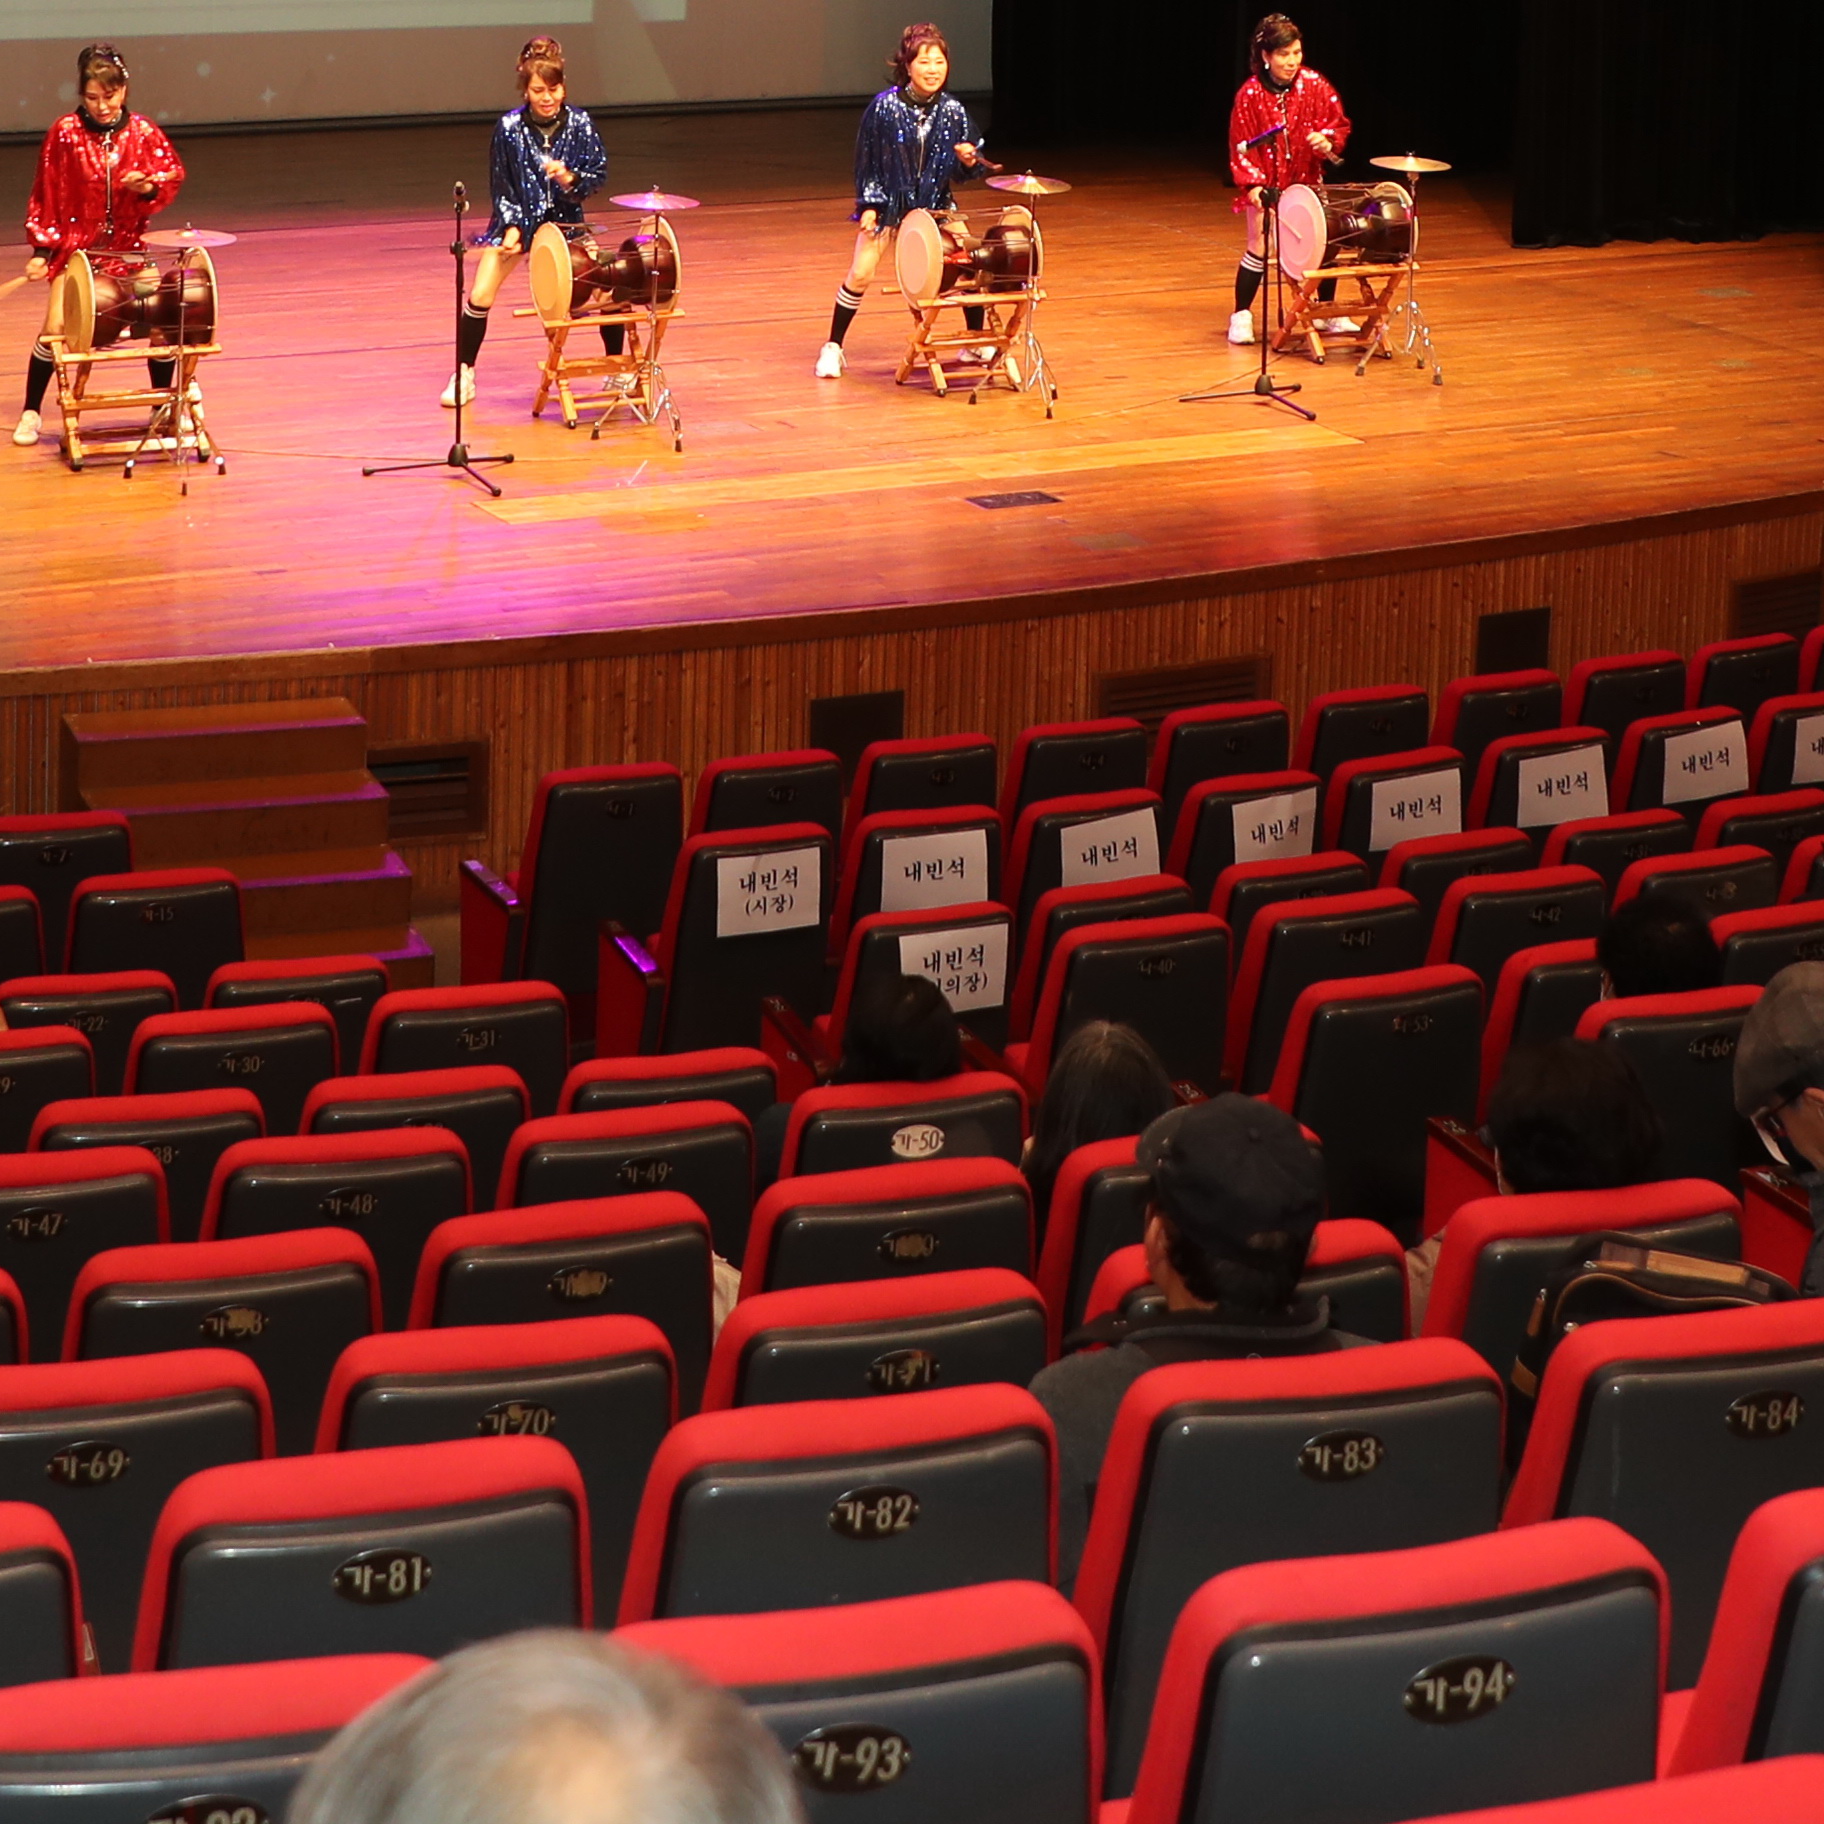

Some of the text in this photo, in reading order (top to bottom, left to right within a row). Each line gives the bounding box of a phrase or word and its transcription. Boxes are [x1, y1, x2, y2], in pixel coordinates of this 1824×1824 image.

[1681, 748, 1730, 774] 내빈석
[1537, 772, 1589, 799] 내빈석
[1390, 796, 1442, 821] 내빈석
[1251, 816, 1300, 844] 내빈석
[1081, 837, 1138, 867] 내빈석
[739, 866, 800, 893] 내빈석
[903, 857, 966, 883] 내빈석
[745, 894, 795, 918] (시장)
[923, 945, 985, 973] 내빈석
[225, 1056, 260, 1072] 가-30
[894, 1130, 941, 1151] 가-50
[622, 1163, 668, 1182] 가-49
[327, 1195, 374, 1216] 가-48
[15, 1215, 64, 1237] 가-47
[1735, 1397, 1800, 1430] 가-84
[53, 1448, 123, 1479] 가-69
[1305, 1438, 1377, 1474] 가-83
[837, 1495, 912, 1531] 가-82
[341, 1556, 422, 1596] 가-81
[1415, 1661, 1505, 1713] 가-94
[802, 1738, 902, 1783] 가-93
